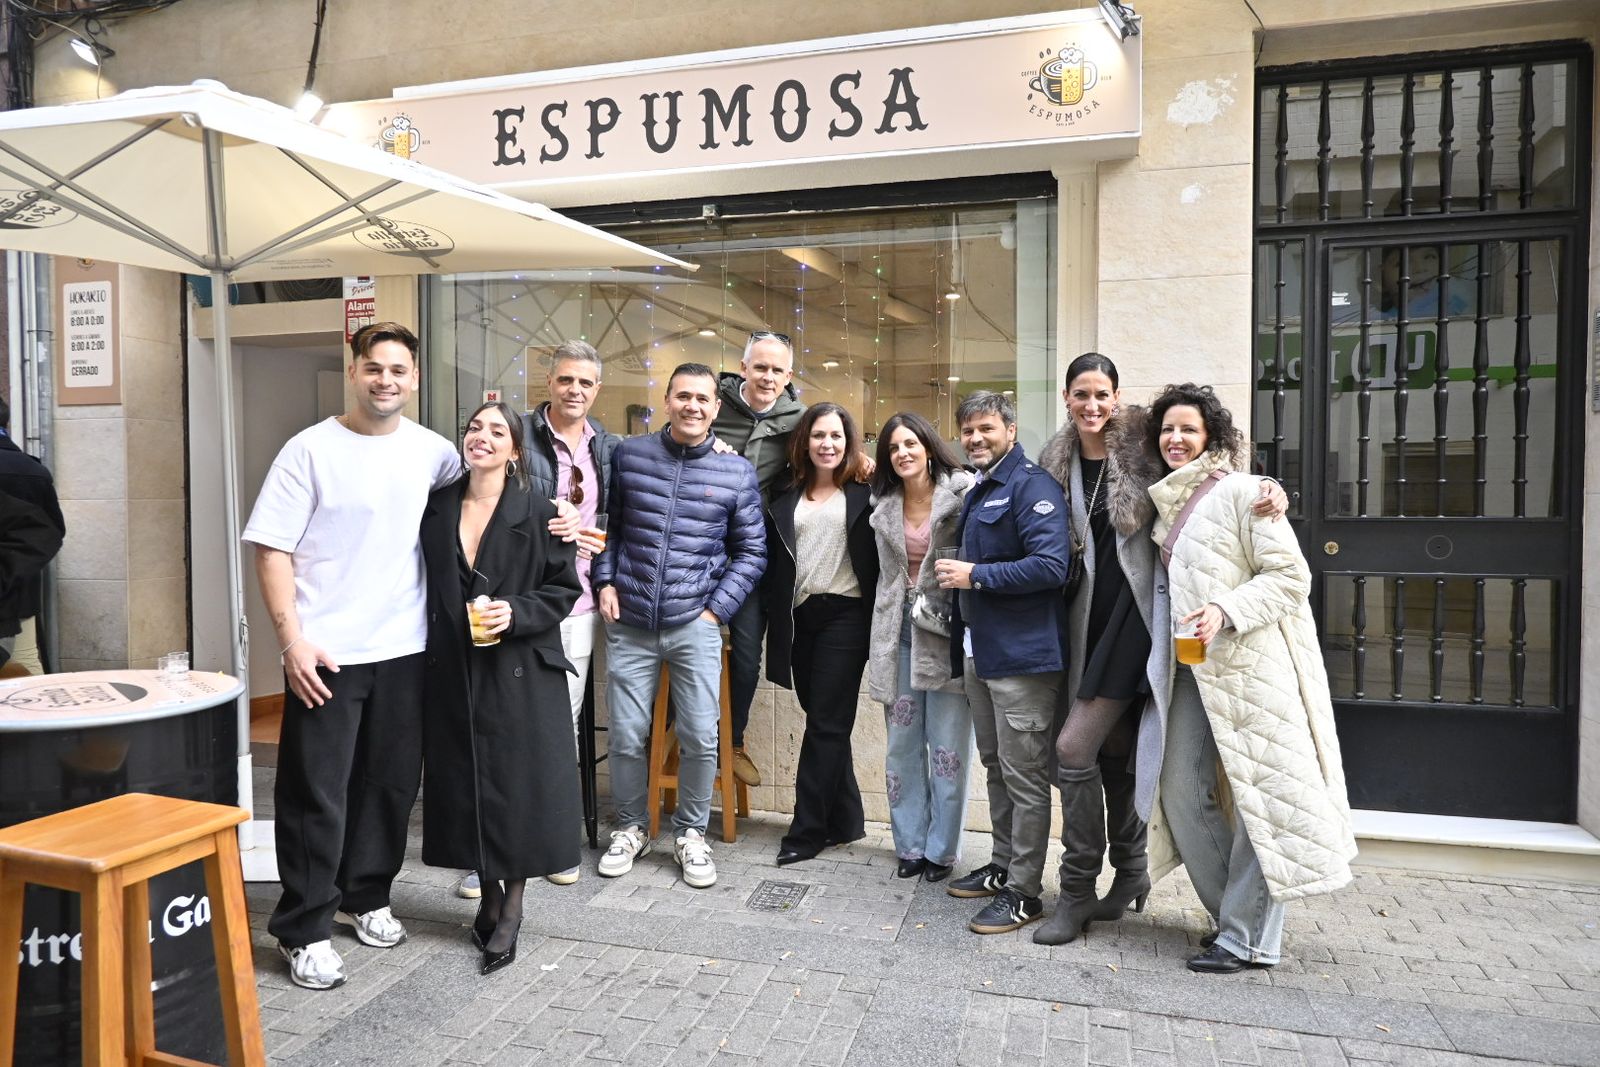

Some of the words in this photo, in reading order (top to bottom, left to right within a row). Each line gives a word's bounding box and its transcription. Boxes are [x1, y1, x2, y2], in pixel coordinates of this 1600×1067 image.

[492, 66, 929, 167] ESPUMOSA
[1029, 99, 1101, 122] ESPUMOSA
[69, 290, 106, 304] HORARIO
[348, 301, 375, 311] Alarm
[85, 317, 90, 326] A
[90, 315, 105, 326] 0:00
[71, 342, 85, 352] 8:00
[86, 342, 90, 351] A
[91, 340, 105, 351] 2:00
[71, 366, 99, 377] CERRADO
[163, 894, 212, 937] Ga
